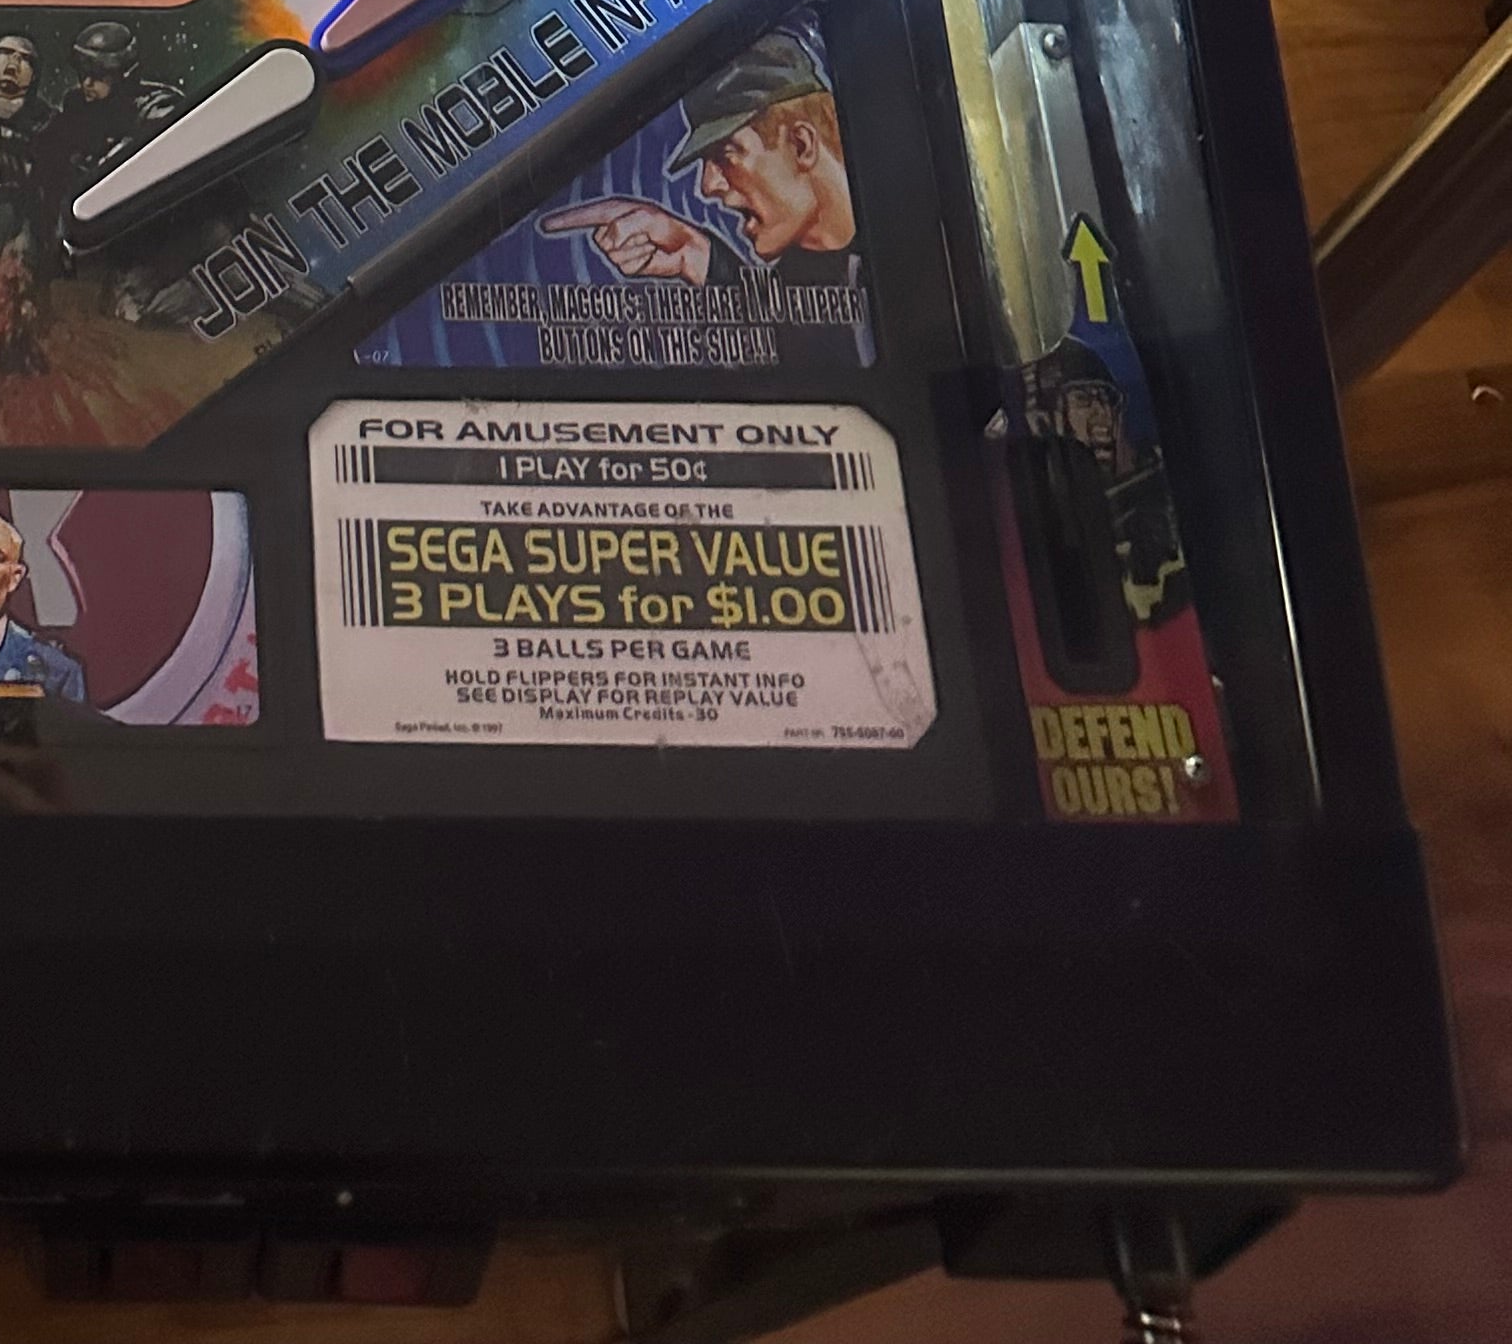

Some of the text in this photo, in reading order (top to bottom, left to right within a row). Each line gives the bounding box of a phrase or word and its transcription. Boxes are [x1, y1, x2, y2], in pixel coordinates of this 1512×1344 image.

[192, 213, 309, 339] JOIN
[289, 135, 424, 251] THE
[402, 10, 598, 179] MOBILE
[440, 267, 865, 326] REMEMBER, MAGGOTS: THERE ARE TWO FLIPPER
[539, 326, 625, 364] BUTTONS
[628, 327, 658, 363] ON
[660, 327, 704, 364] THIS
[359, 418, 839, 446] FOR AMUSEMENT ONLY
[516, 456, 590, 481] PLAY
[598, 458, 643, 480] for
[649, 457, 708, 483] 50¢
[480, 500, 734, 519] TAKE ADVANTAGE OF THE
[387, 525, 841, 579] SEGA SUPER VALUE
[391, 581, 847, 630] 3 PLAYS for $1.00
[493, 637, 751, 661] 3 BALLS PER GAME
[445, 668, 806, 689] HOLD FLIPPERS FOR INSTANT INFO
[456, 686, 799, 707] SEE DISPLAY FOR REPLAY VALUE
[538, 705, 620, 720] Maximum
[623, 706, 685, 721] Credits
[1029, 704, 1197, 760] DEFEND
[1051, 765, 1181, 816] OURS!
